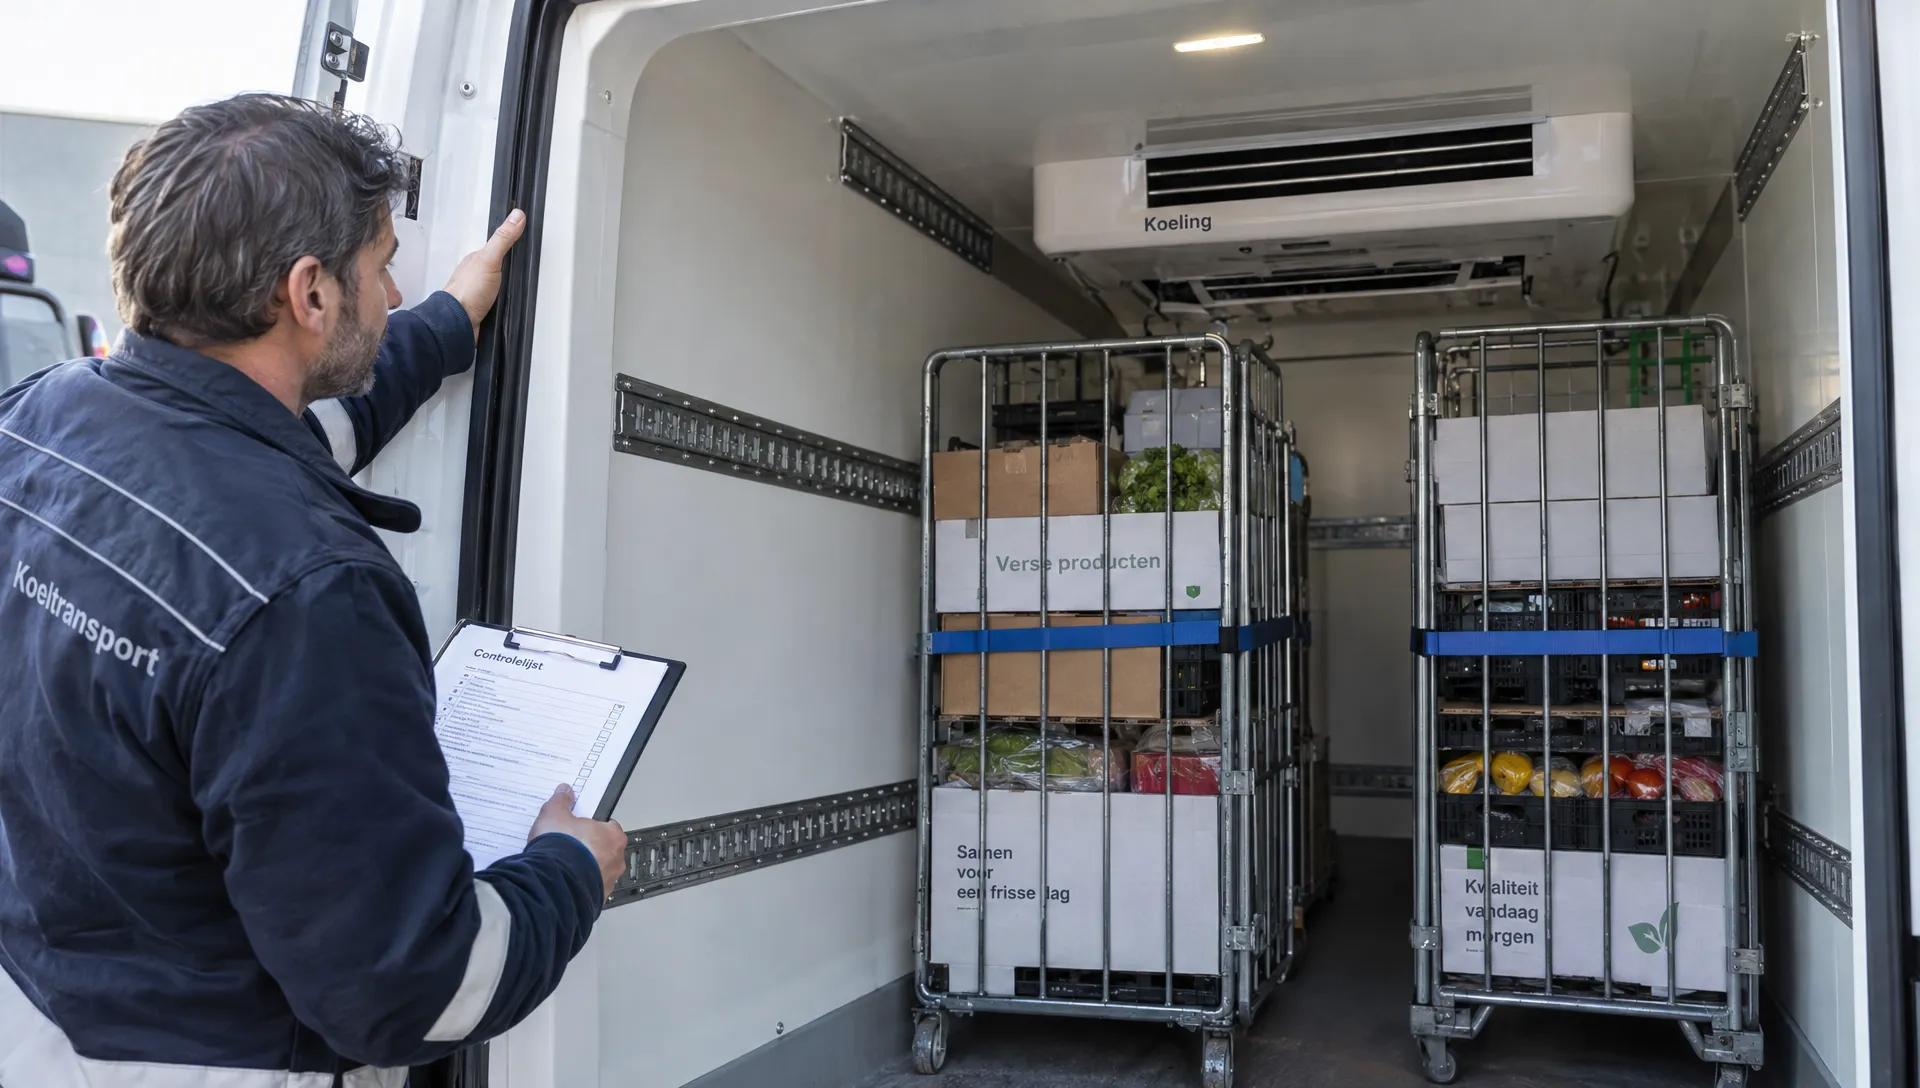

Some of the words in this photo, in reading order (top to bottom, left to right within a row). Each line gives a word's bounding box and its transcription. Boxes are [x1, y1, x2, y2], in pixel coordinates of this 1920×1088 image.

[1144, 214, 1212, 232] Koeling
[1059, 553, 1161, 574] producten
[13, 560, 160, 677] Koeltransport
[473, 648, 544, 670] Controlelijst
[990, 884, 1036, 900] frisse
